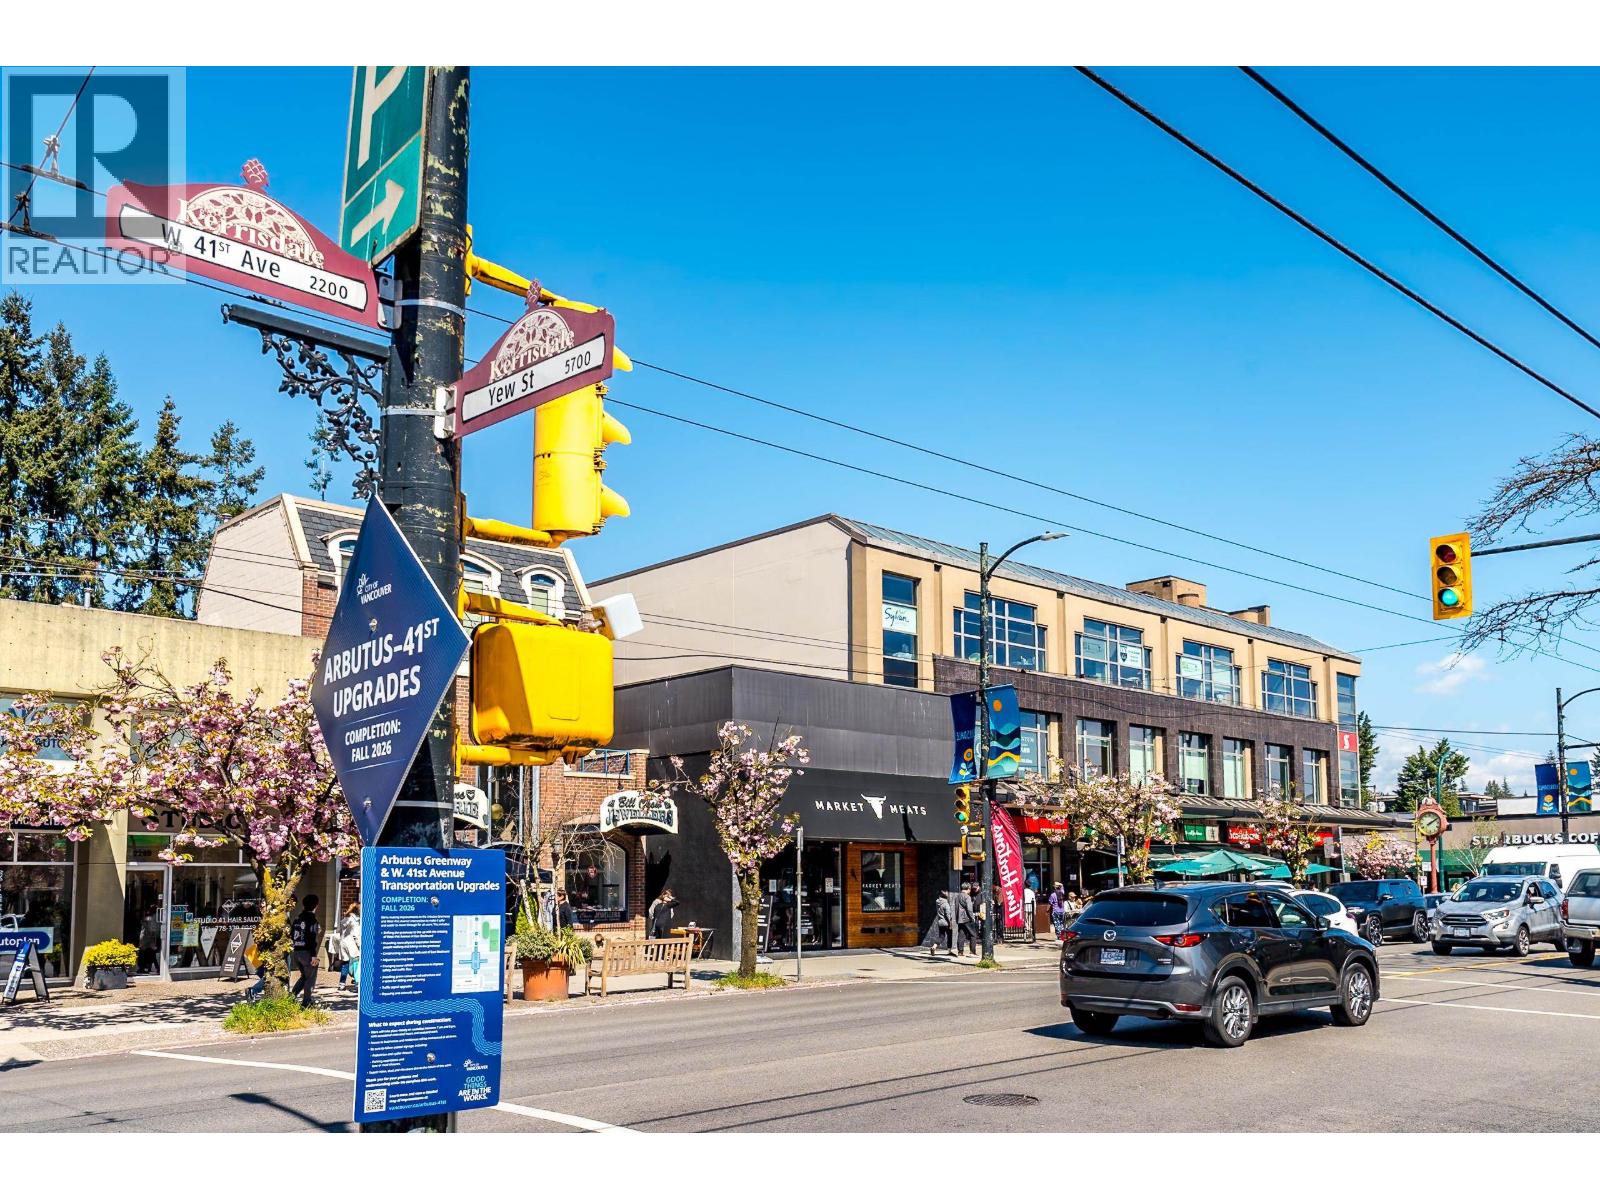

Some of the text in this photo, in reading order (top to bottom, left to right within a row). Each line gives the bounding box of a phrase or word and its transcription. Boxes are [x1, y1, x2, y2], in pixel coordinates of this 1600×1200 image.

[176, 198, 325, 267] Kerrisdale
[194, 236, 230, 259] 41ST
[241, 250, 281, 279] Ave
[309, 275, 348, 300] 2200
[489, 330, 575, 382] Kerrisdale
[488, 350, 592, 406] Yew St 5700
[360, 583, 392, 605] VANCOUVER
[333, 665, 421, 717] UPGRADES
[344, 721, 401, 746] COMPLETION:
[351, 740, 392, 763] FALL 2026
[815, 800, 927, 816] MARKET MEATS
[380, 855, 473, 868] Arbutus Greenway
[380, 868, 465, 878] & W. 41st Avenue
[380, 880, 501, 892] Transportation Upgrades
[381, 896, 429, 904] COMPLETION:
[399, 904, 415, 912] 2026
[464, 1081, 487, 1089] THINGS
[465, 1075, 485, 1083] GOOD
[458, 1089, 471, 1097] ARE
[464, 1094, 488, 1102] WORKS.
